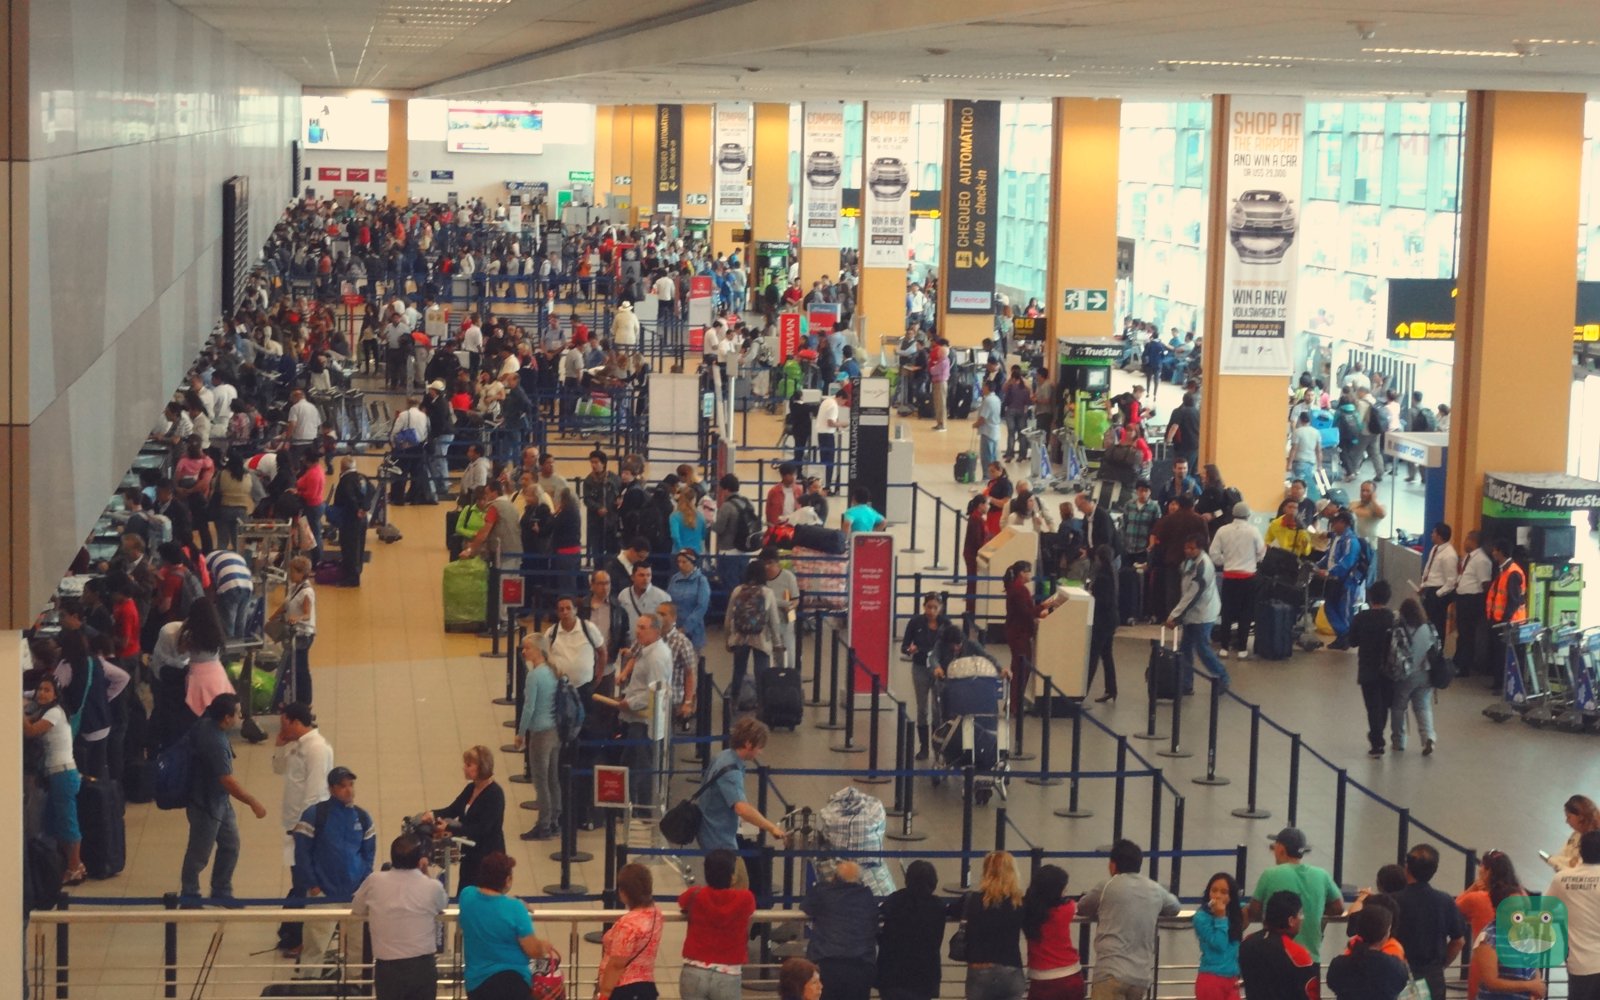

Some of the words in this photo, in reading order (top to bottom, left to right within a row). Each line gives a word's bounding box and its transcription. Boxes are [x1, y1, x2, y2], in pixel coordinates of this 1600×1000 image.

[870, 111, 897, 125] SHOP
[1234, 111, 1278, 135] SHOP
[1281, 112, 1302, 136] AT
[959, 106, 974, 186] AUTOMÁTICO
[1233, 135, 1251, 151] THE
[1254, 136, 1299, 153] AIRPORT
[1233, 153, 1251, 167] AND
[1254, 154, 1271, 167] WIN
[1273, 154, 1279, 167] A
[1281, 154, 1298, 168] CAR
[975, 169, 988, 215] check-in
[890, 216, 905, 226] NEW
[957, 190, 972, 248] CHEQUEO
[973, 221, 986, 247] Auto
[953, 296, 989, 304] American
[1232, 289, 1253, 304] WIN
[1254, 290, 1262, 304] A
[1264, 290, 1287, 305] NEW
[1232, 307, 1276, 318] VOLKSWAGEN
[1277, 308, 1287, 318] CC
[1084, 346, 1122, 357] TrueStar
[1488, 479, 1533, 507] TrueStar
